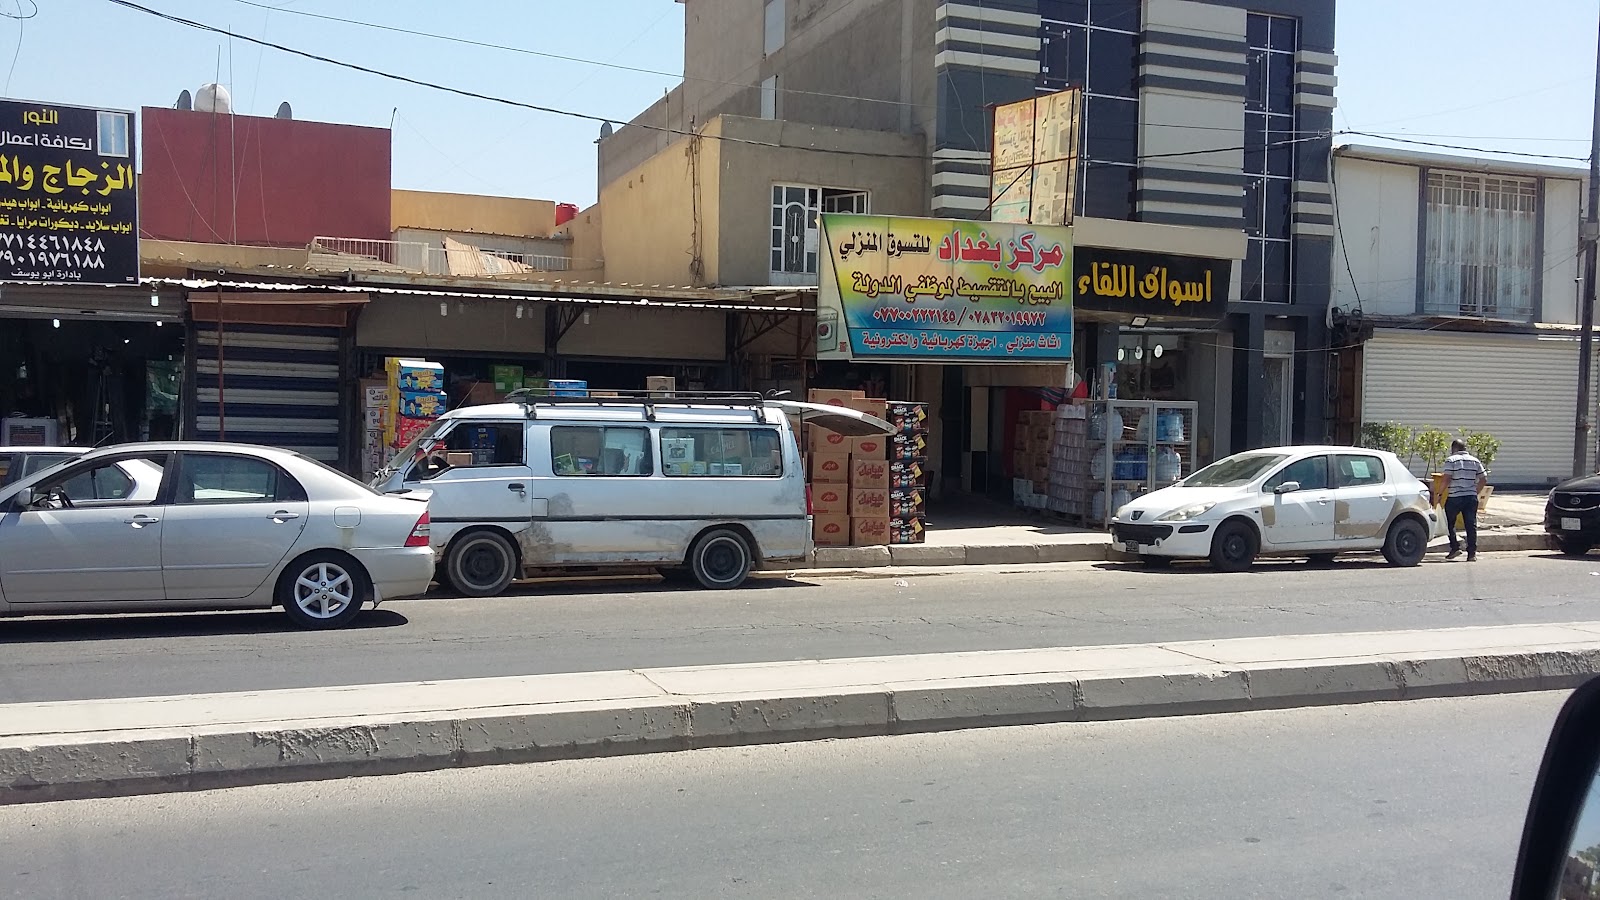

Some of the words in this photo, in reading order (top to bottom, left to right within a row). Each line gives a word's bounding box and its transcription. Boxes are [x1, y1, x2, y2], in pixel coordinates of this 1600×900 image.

[23, 108, 58, 126] النور
[0, 130, 38, 146] اعمال
[40, 133, 92, 150] لكافة
[42, 159, 134, 196] الزجاج
[18, 198, 40, 211] ابواب
[90, 202, 112, 215] ابواب
[16, 215, 37, 229] مرايا
[39, 216, 79, 231] ديكورات
[85, 219, 110, 232] سلايد
[111, 221, 133, 234] ابواب
[0, 233, 106, 253] ٧١٤٤٦١٨٤٨
[838, 231, 883, 260] المنزلي
[886, 232, 932, 258] للتسوق
[938, 229, 1002, 270] بغداد
[1006, 233, 1065, 272] مركز
[11, 267, 40, 279] يوسف
[42, 270, 55, 280] ابو
[1077, 261, 1136, 298] اللقاء
[851, 271, 902, 297] الدولة
[904, 274, 954, 303] لموظفي
[956, 276, 1026, 304] بالتقسيط
[1138, 265, 1212, 307] اسواق
[1027, 281, 1064, 305] البيع
[967, 335, 996, 351] اجهزة
[1006, 336, 1036, 353] منزلي
[1037, 334, 1061, 349] اثاث
